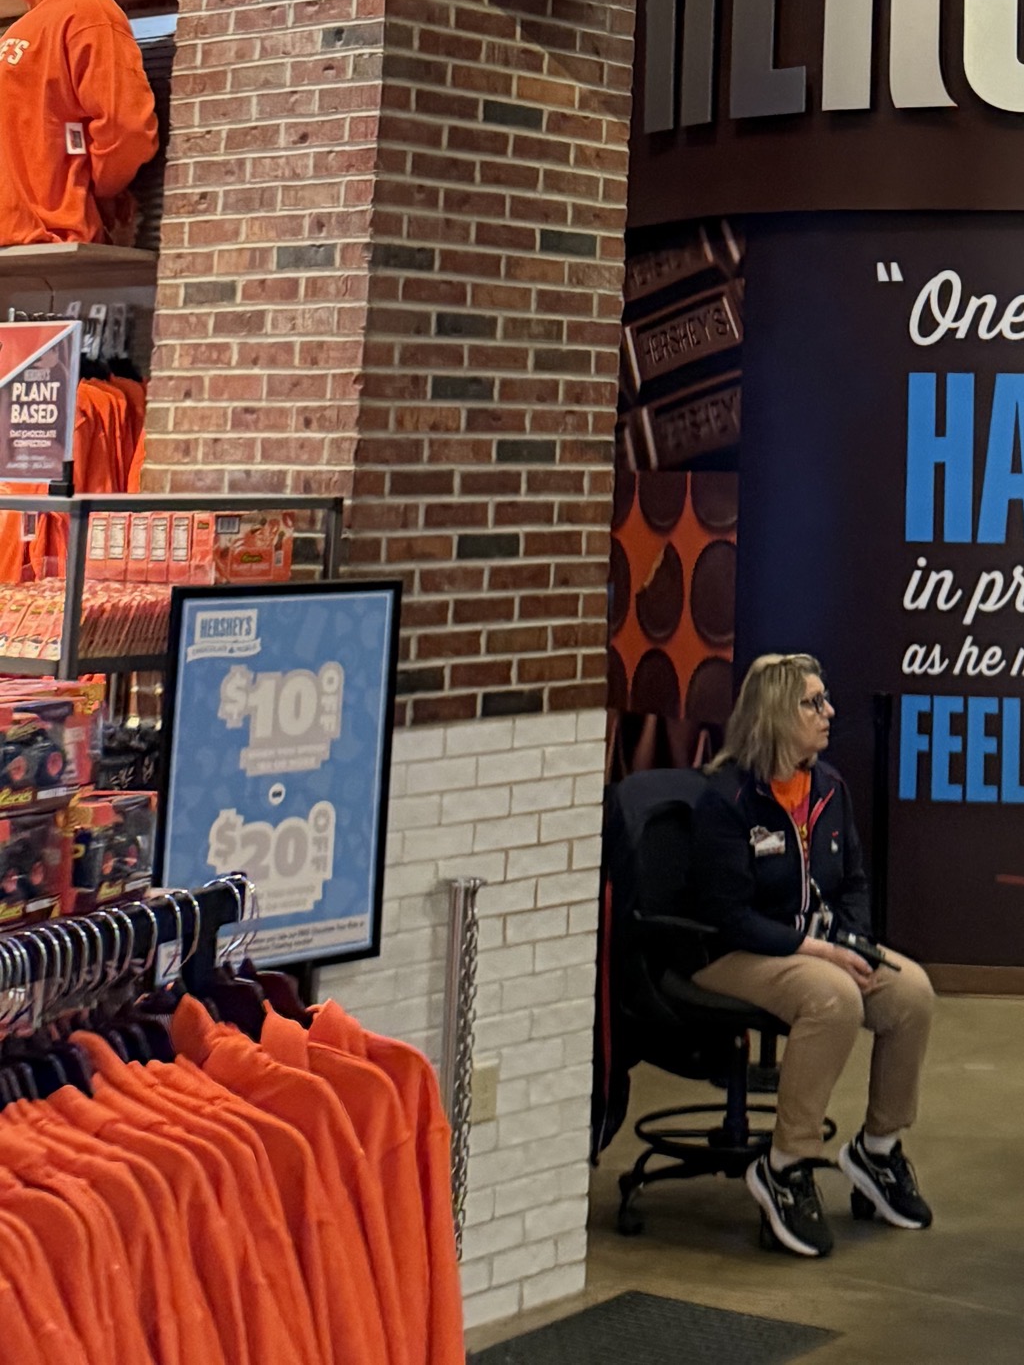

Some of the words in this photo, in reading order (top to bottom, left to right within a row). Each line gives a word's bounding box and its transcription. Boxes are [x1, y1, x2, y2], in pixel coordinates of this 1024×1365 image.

[10, 404, 58, 424] BASED
[12, 382, 60, 402] PLANT
[902, 556, 963, 611] in
[902, 641, 949, 676] as
[953, 636, 1006, 677] he
[222, 672, 318, 739] $10
[213, 816, 309, 881] $20
